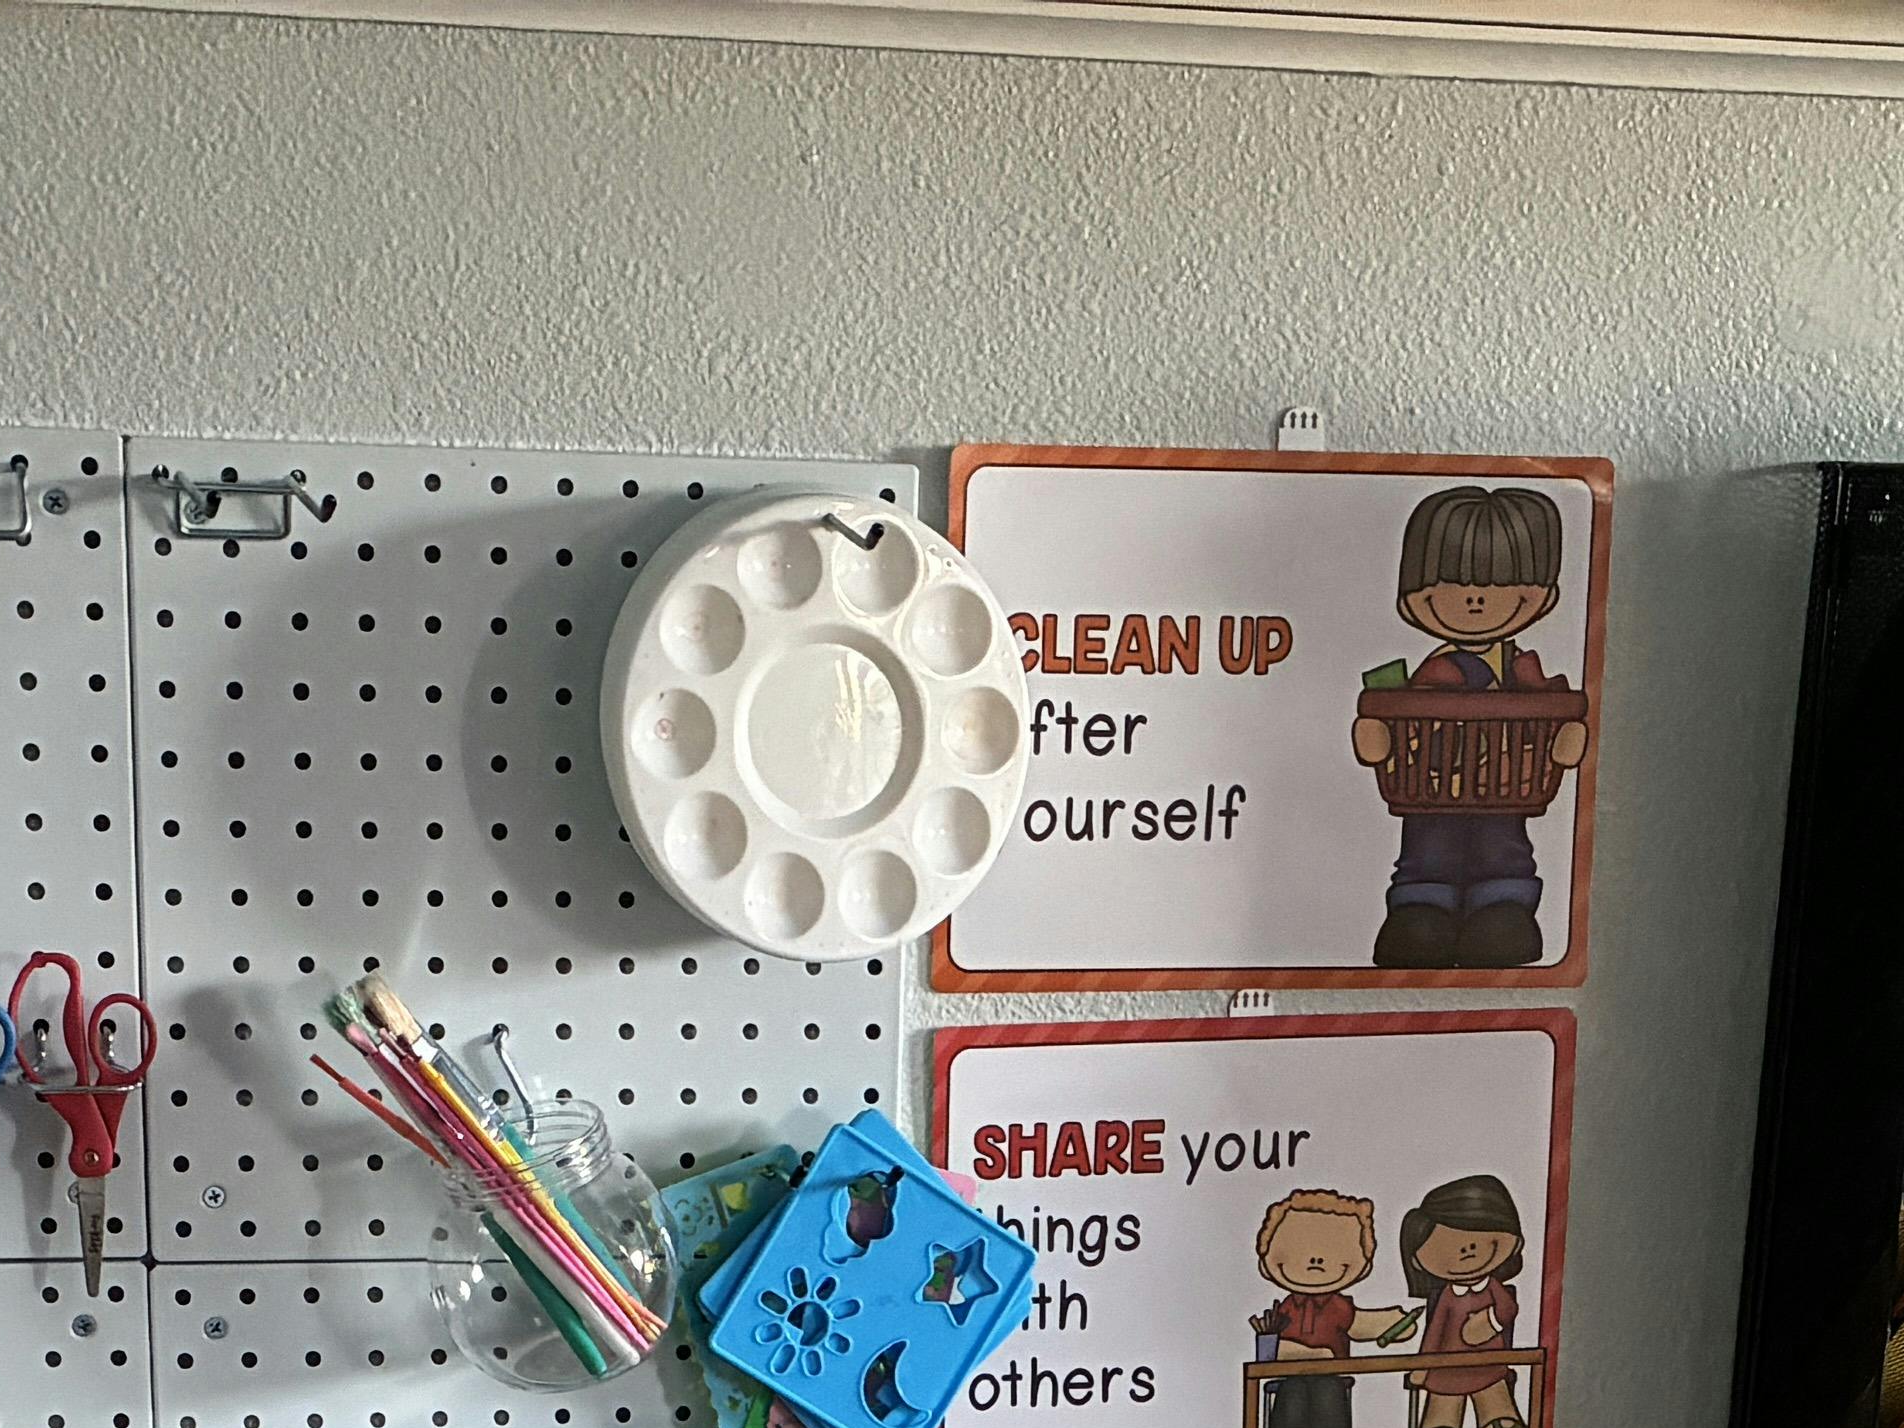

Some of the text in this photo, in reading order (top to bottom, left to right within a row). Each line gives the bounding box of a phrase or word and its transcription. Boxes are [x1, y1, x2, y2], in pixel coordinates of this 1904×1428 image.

[1007, 612, 1294, 677] CLEAN UP
[1029, 699, 1148, 757] fter
[1023, 782, 1247, 843] ourself
[973, 1119, 1311, 1185] SHARE your
[976, 1204, 1142, 1268] hings
[1022, 1279, 1089, 1332] th
[968, 1356, 1156, 1411] others
